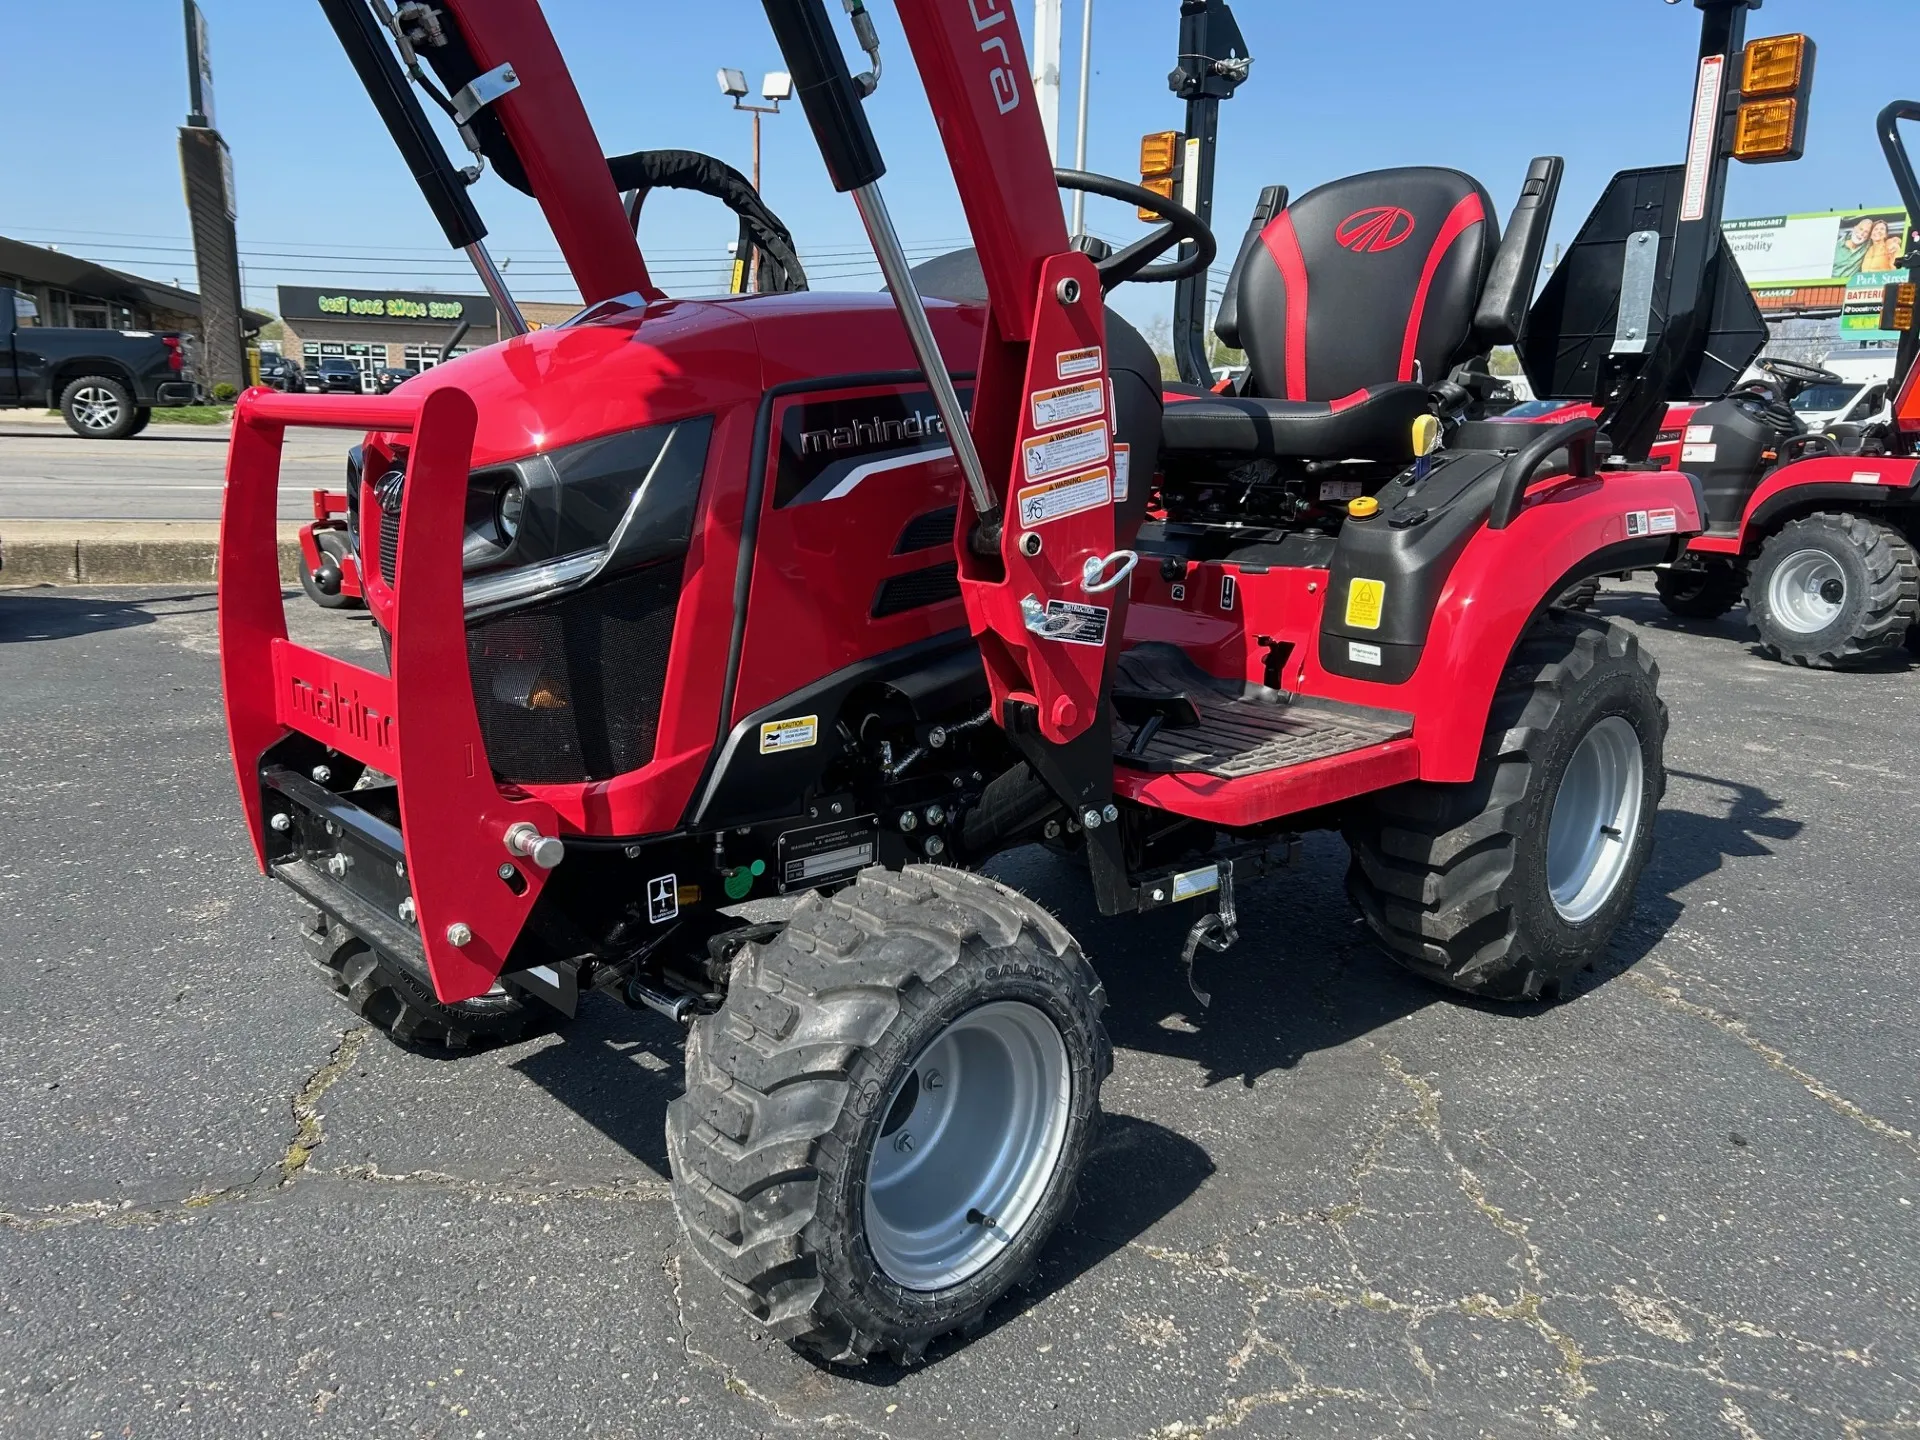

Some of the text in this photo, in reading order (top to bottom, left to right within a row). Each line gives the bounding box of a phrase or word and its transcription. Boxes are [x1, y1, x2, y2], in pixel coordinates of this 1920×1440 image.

[1747, 218, 1783, 227] MEDICARE?
[1731, 241, 1773, 252] lexibility
[1856, 274, 1877, 285] Park
[1759, 289, 1792, 298] LAMAR
[1847, 289, 1884, 300] BATTERI
[429, 302, 463, 318] SHOP
[1851, 305, 1884, 313] boostmob
[322, 345, 342, 353] OPEN
[1057, 385, 1085, 397] WARNING
[1055, 428, 1083, 441] WARNING
[1054, 476, 1082, 489] WARNING
[1063, 604, 1095, 614] INSTRUCTION
[292, 677, 394, 753] mahin
[782, 720, 804, 729] CAUTION
